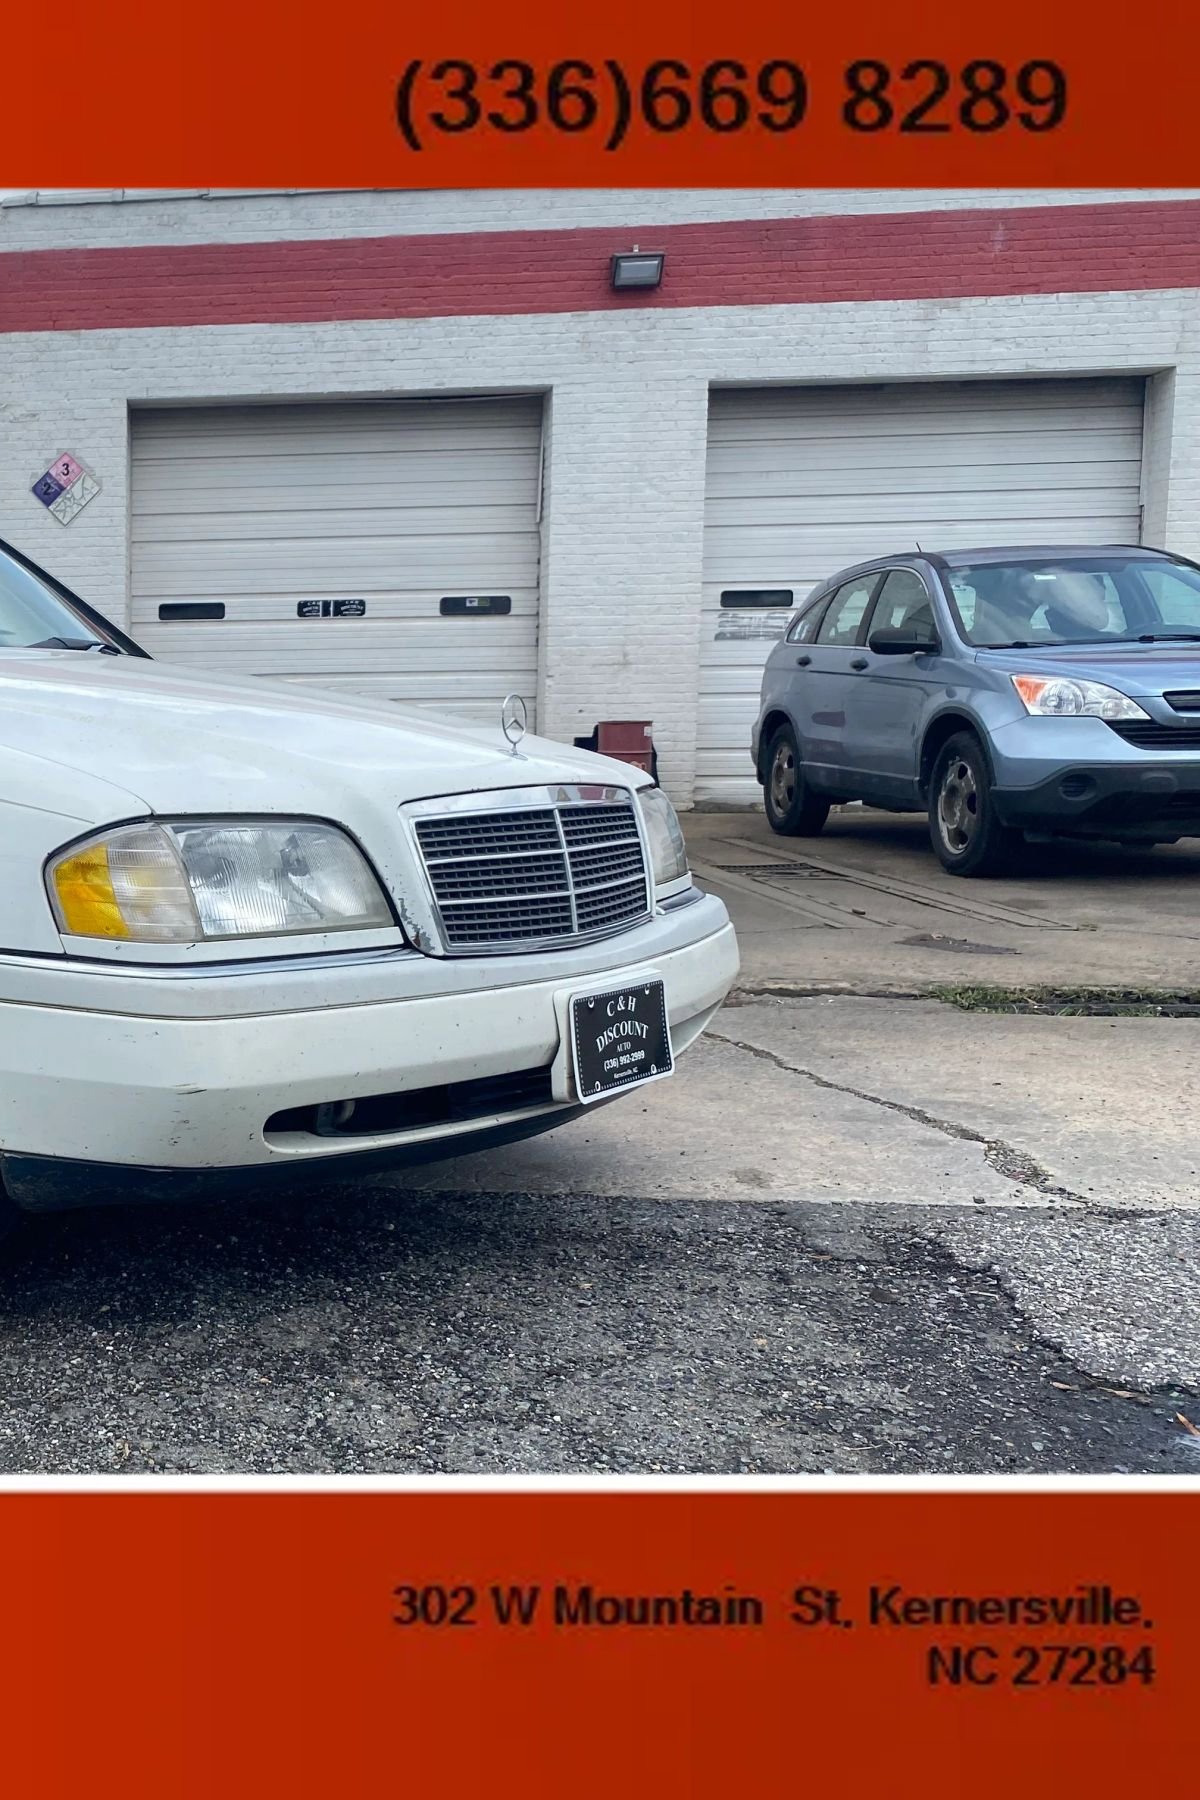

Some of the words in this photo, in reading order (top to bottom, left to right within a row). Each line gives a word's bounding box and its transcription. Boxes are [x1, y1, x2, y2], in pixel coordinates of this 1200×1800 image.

[61, 463, 70, 476] 3
[606, 1001, 615, 1017] C
[617, 995, 625, 1011] &
[627, 995, 636, 1012] H
[595, 1020, 649, 1053] DISCOUNT
[617, 1042, 631, 1052] AUTO
[603, 1057, 619, 1072] (336)
